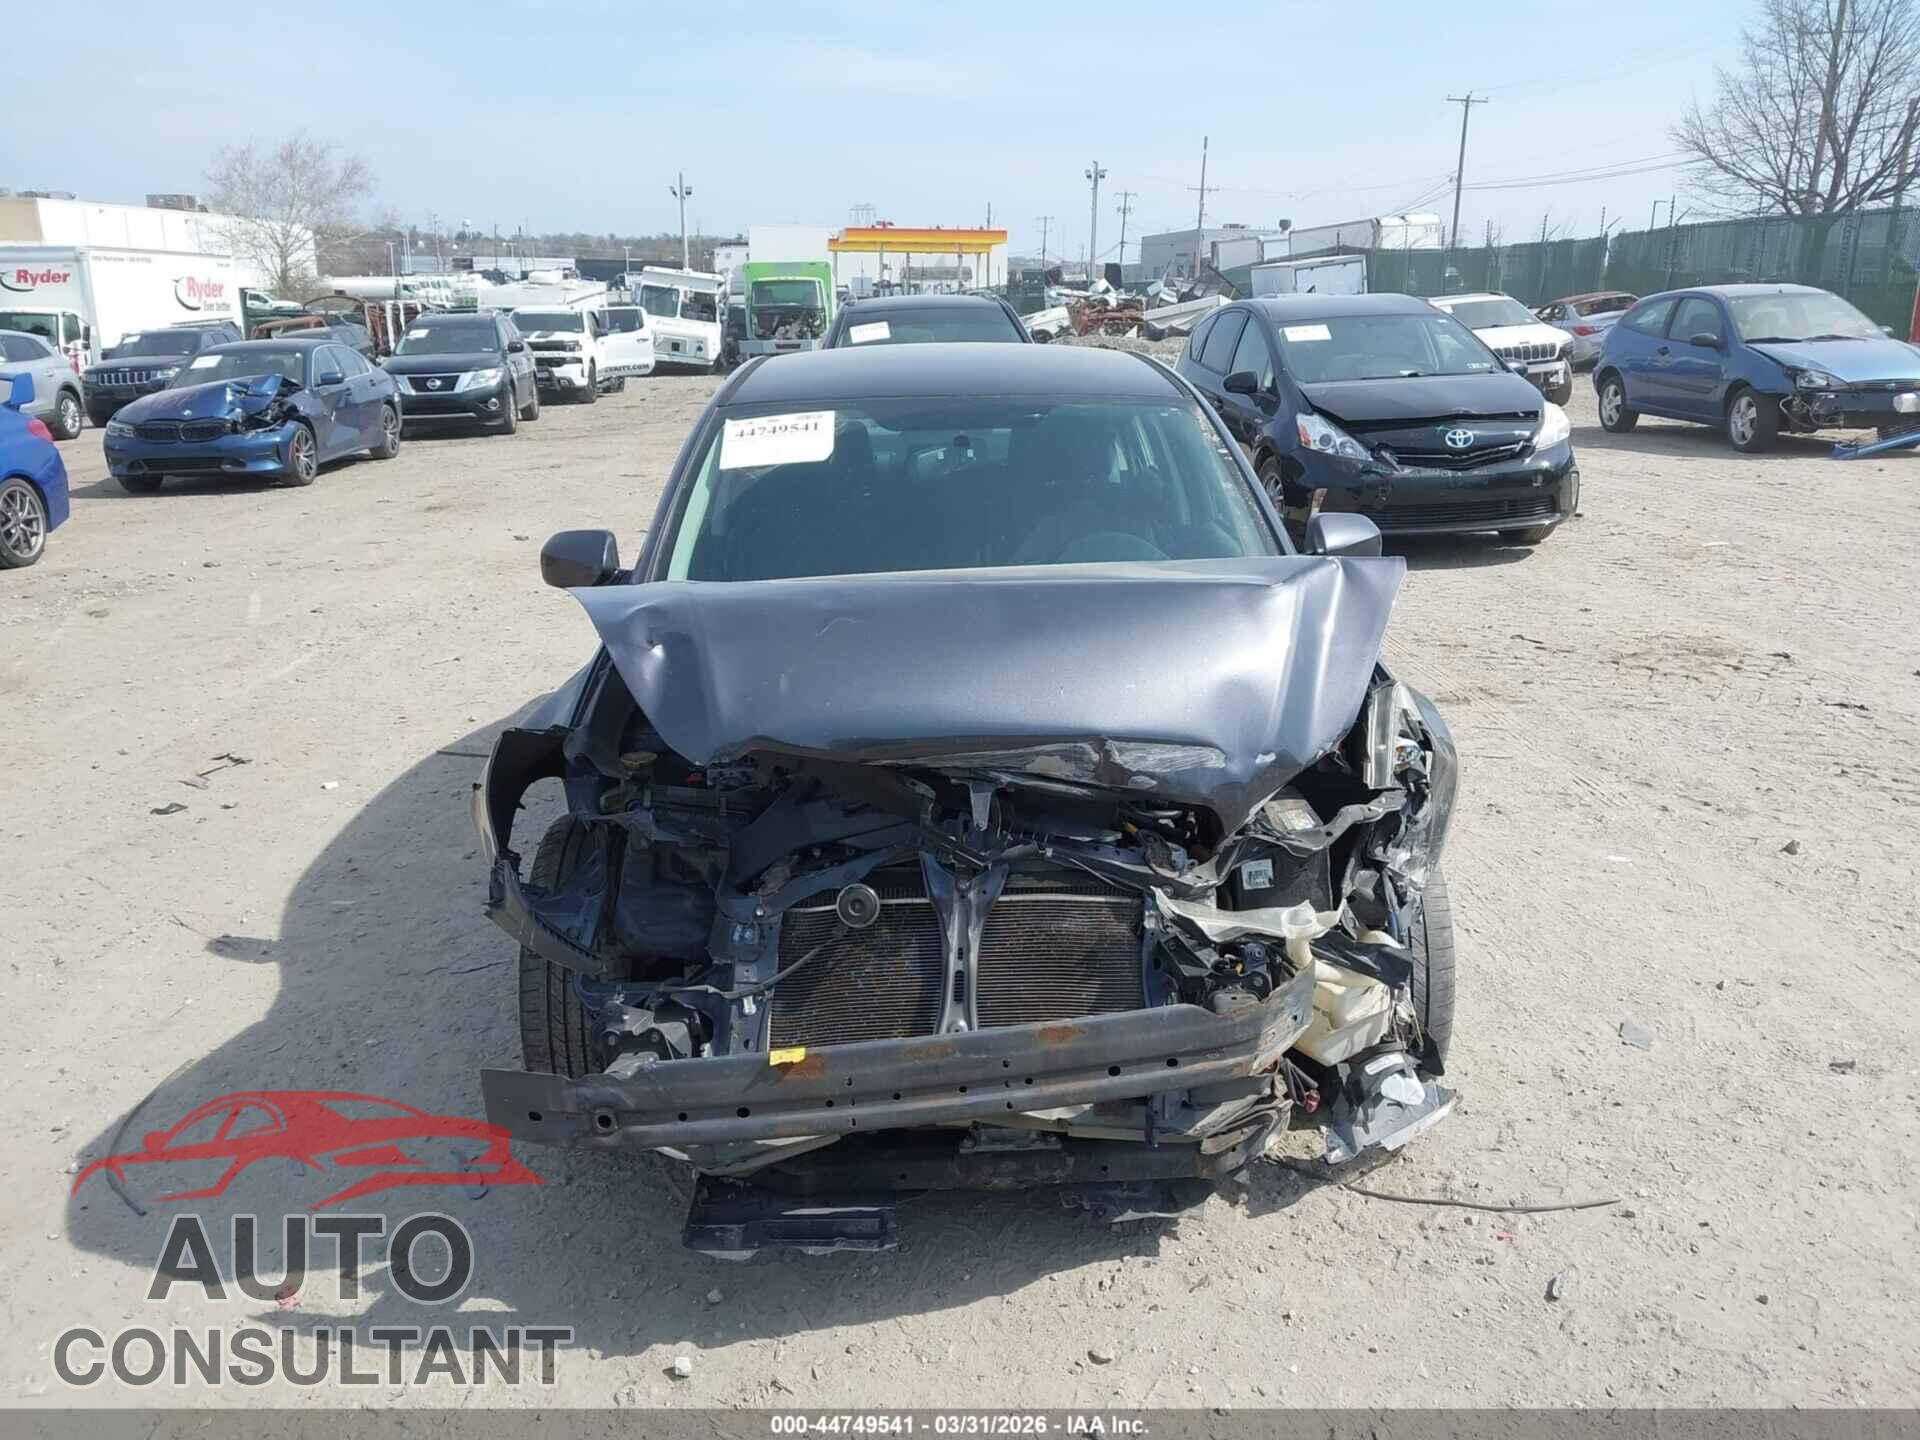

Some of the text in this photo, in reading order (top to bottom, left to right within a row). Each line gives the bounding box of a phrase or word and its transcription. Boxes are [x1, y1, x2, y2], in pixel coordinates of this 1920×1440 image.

[16, 269, 70, 286] Ryder
[187, 276, 224, 302] Ryder
[736, 422, 818, 437] 44749541
